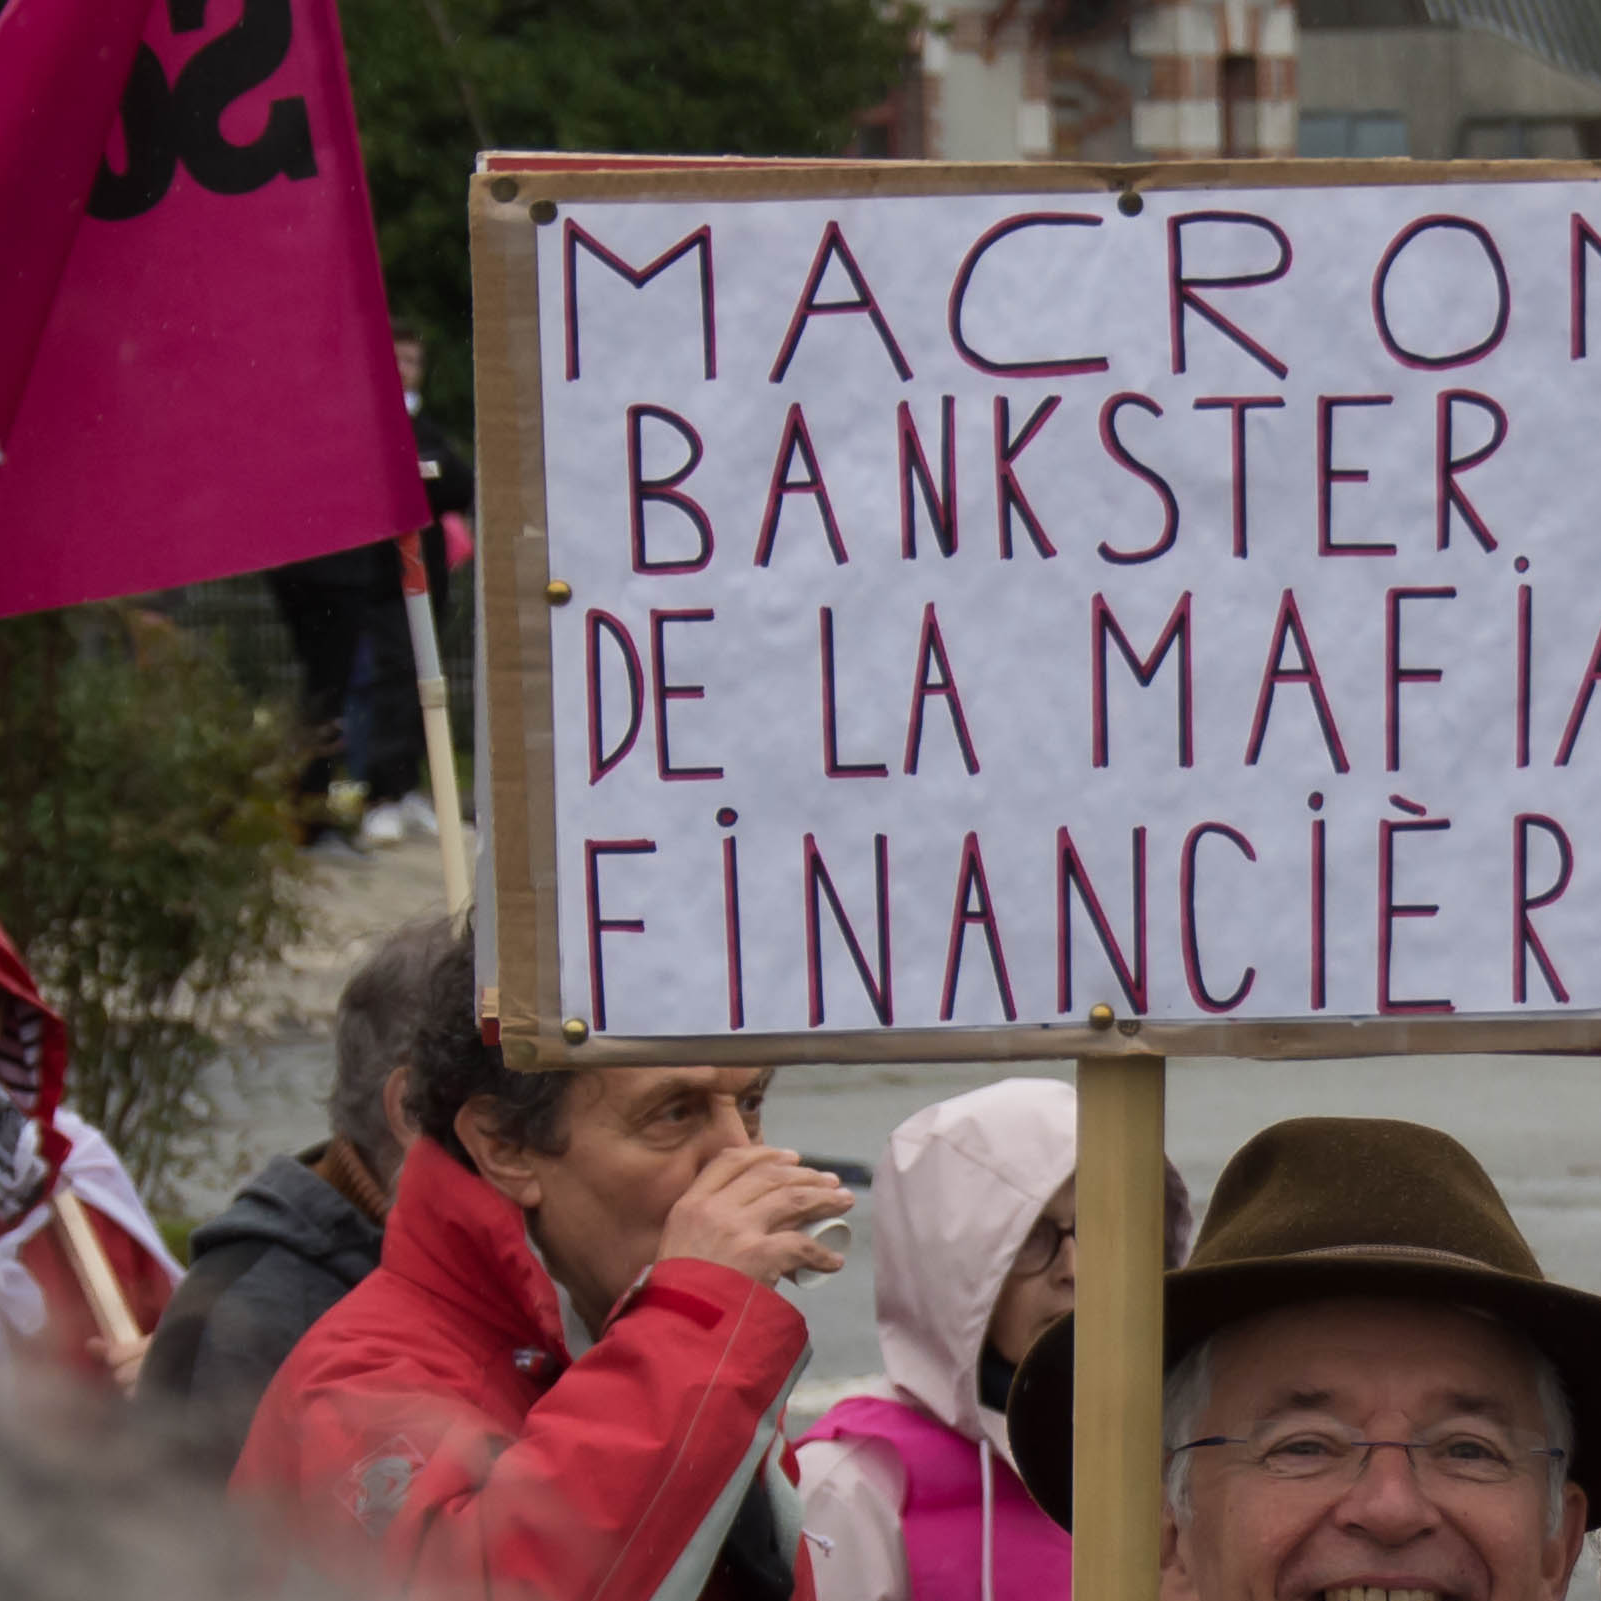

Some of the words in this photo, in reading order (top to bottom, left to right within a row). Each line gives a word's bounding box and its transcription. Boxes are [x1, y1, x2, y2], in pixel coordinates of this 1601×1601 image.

[626, 389, 1509, 575] BANKSTER
[585, 606, 725, 784] DE
[818, 600, 980, 776] LA
